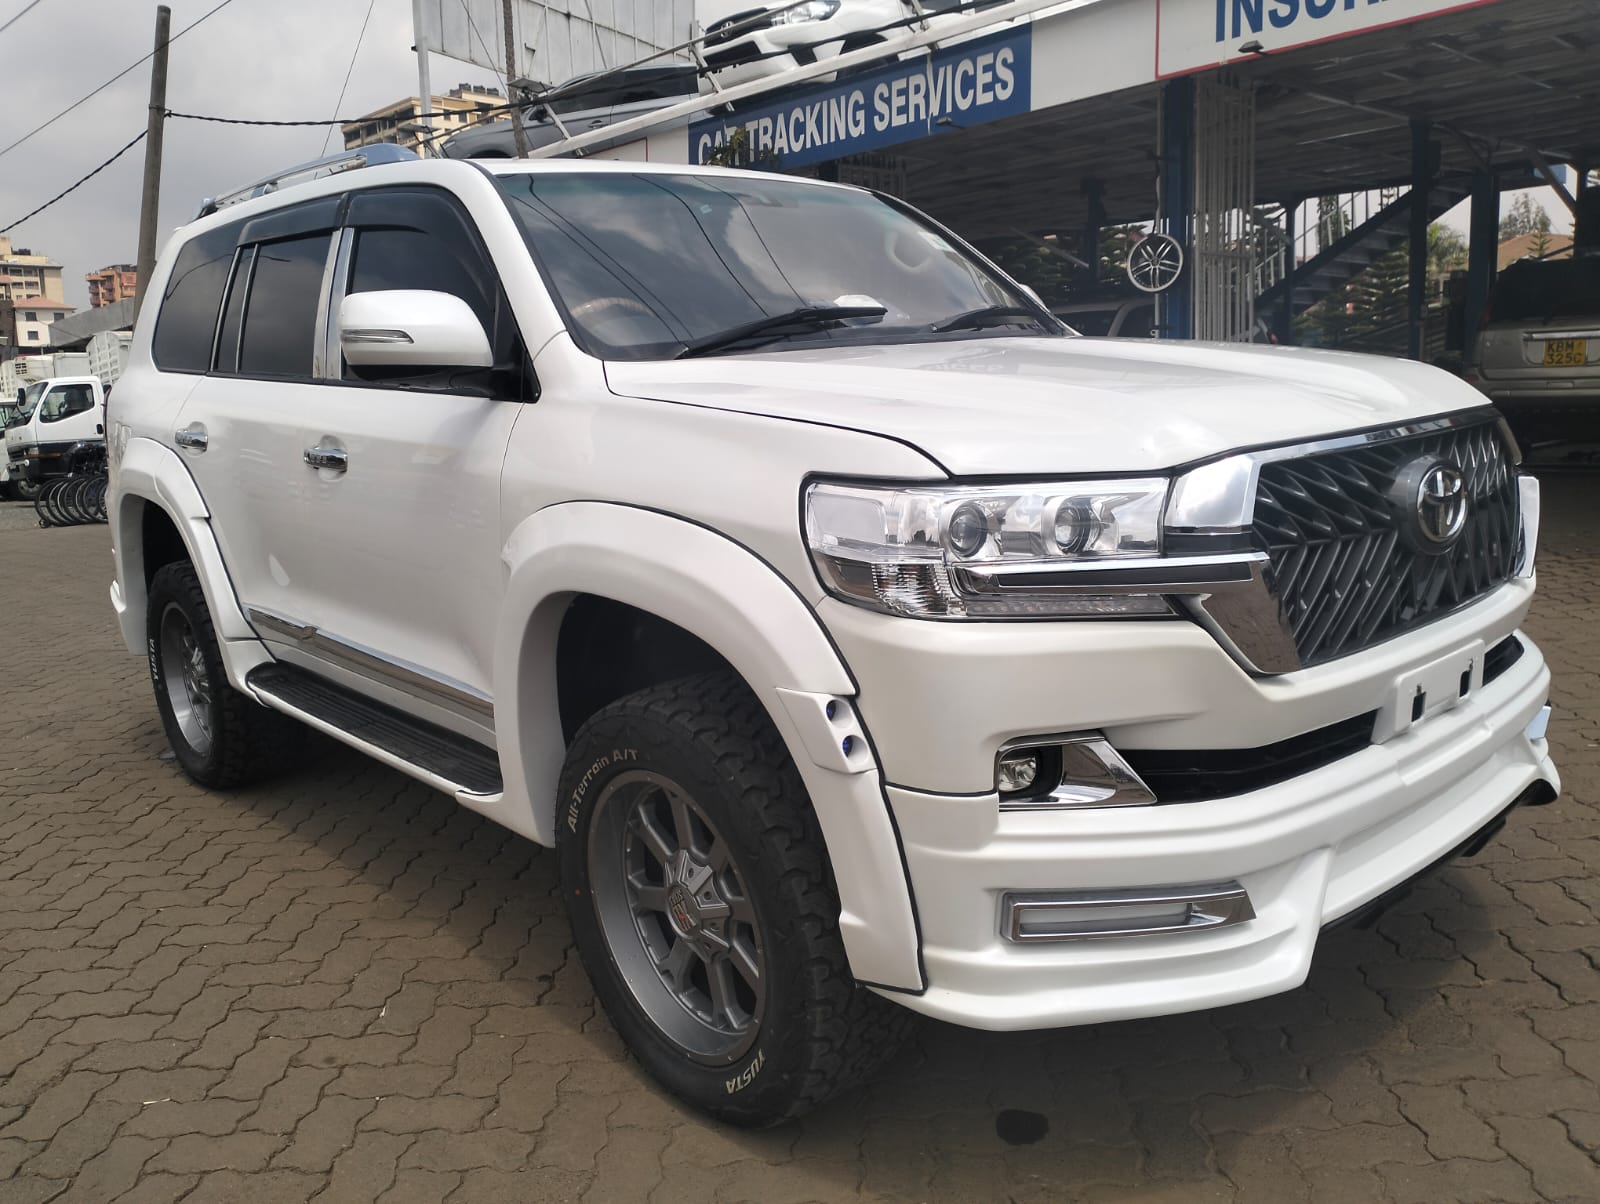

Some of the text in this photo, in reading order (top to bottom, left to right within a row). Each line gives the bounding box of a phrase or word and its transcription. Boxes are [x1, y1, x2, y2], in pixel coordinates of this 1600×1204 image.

[1216, 0, 1391, 43] INS
[744, 90, 866, 163] TRACKING
[873, 47, 1015, 132] SERVICES
[567, 748, 639, 833] All-Terrain A/T
